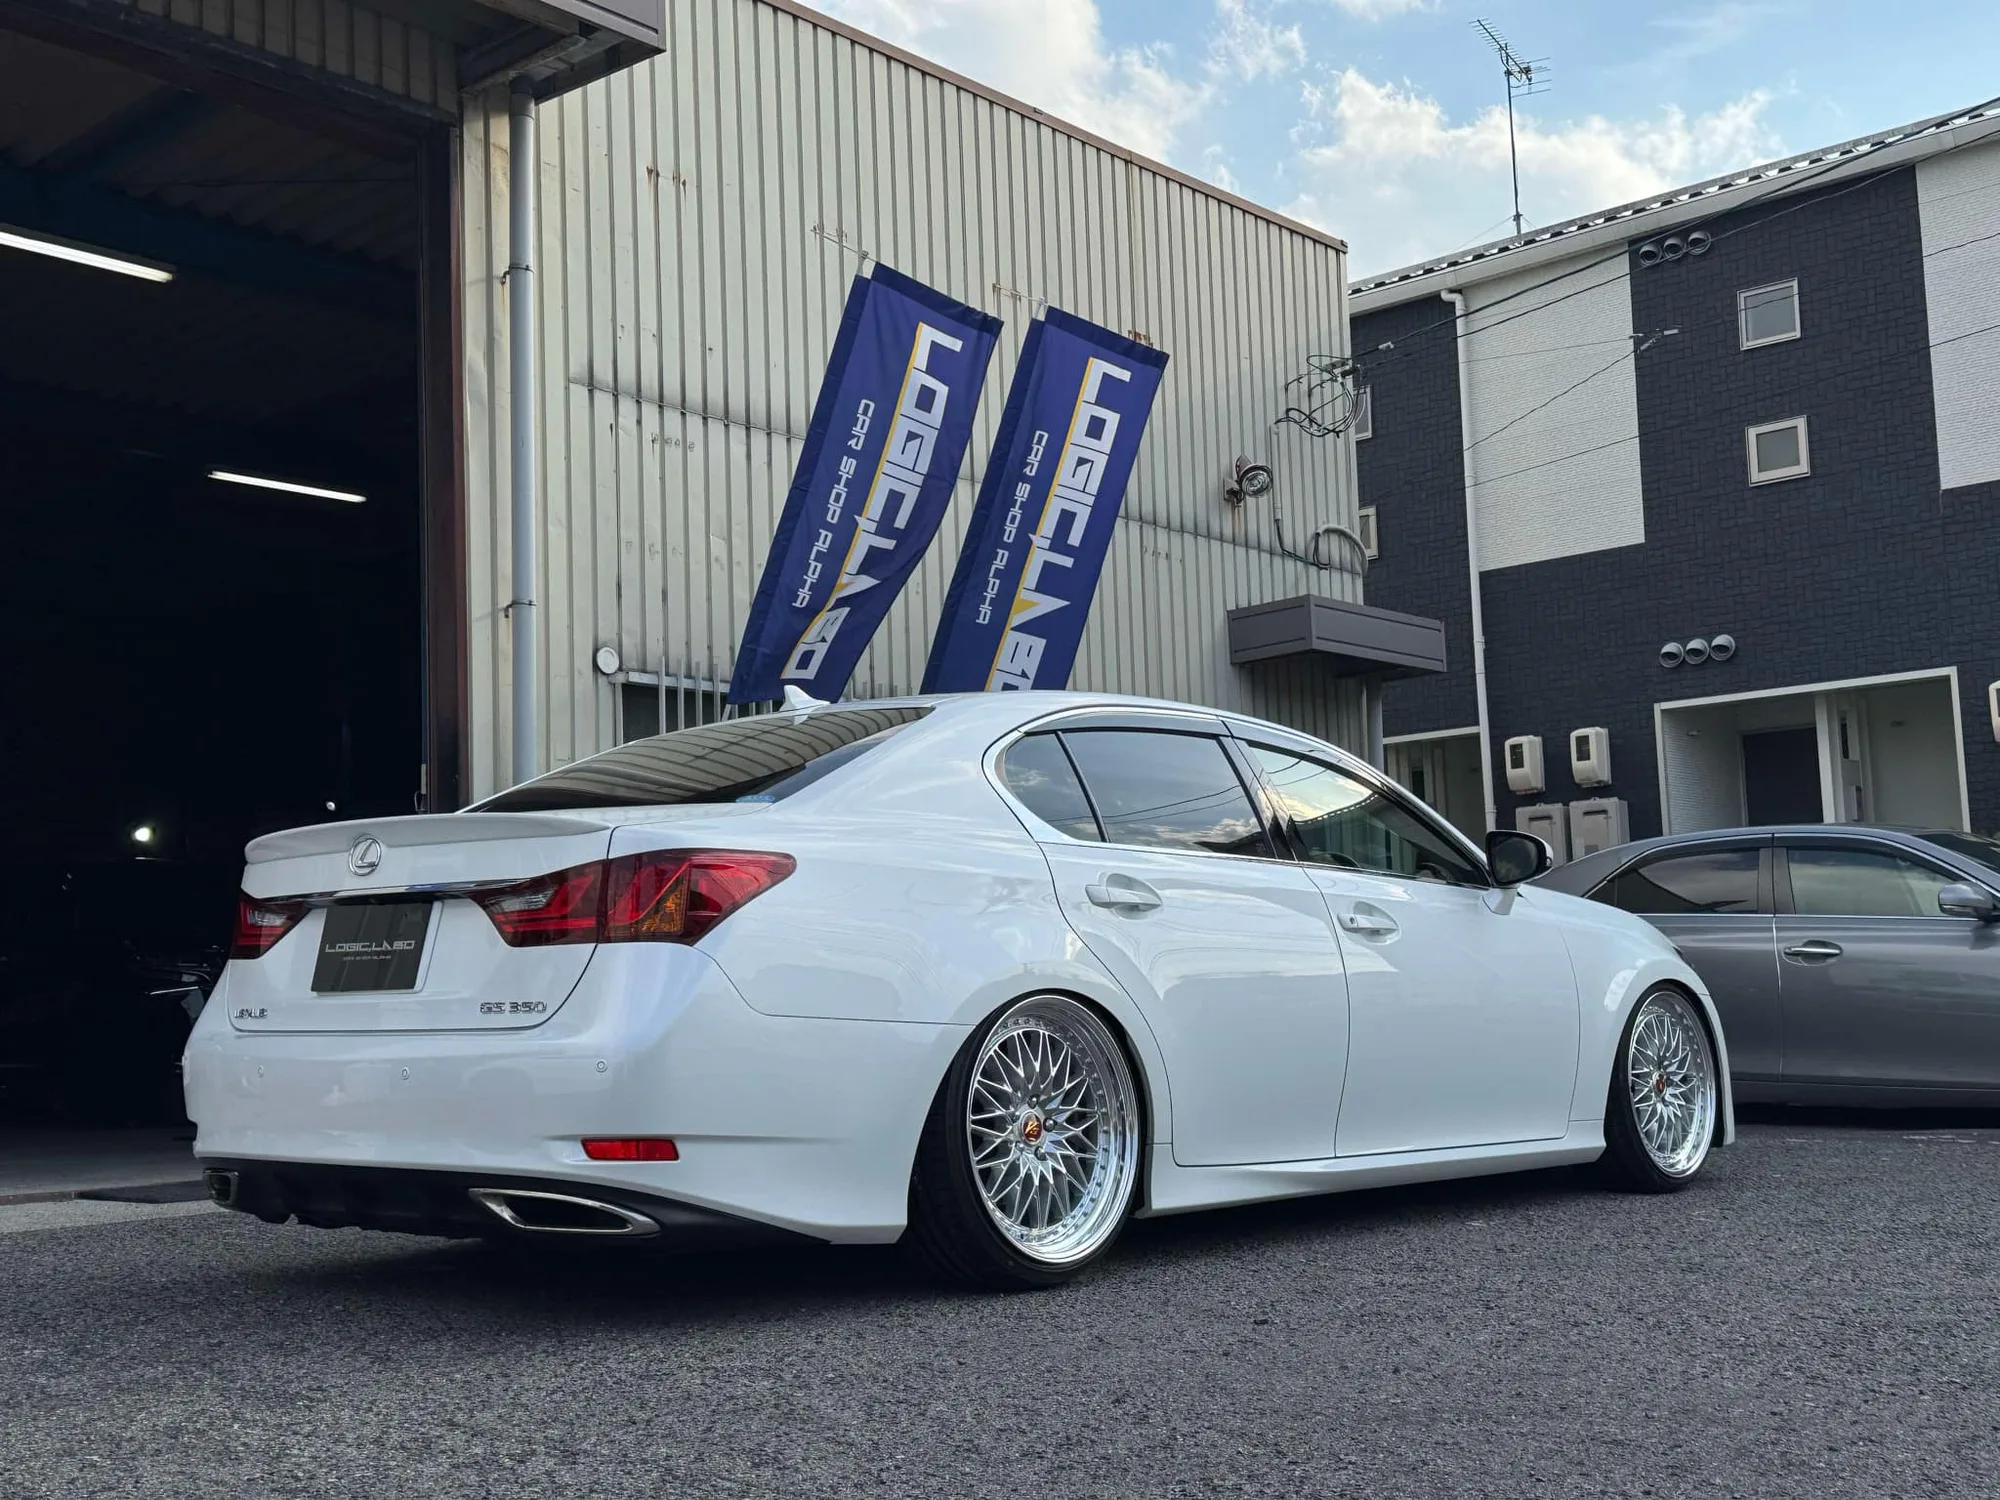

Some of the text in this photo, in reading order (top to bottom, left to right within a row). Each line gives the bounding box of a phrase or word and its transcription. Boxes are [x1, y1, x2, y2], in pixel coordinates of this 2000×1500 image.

[792, 399, 875, 608] CAR SHOP ALPHA
[976, 430, 1048, 624] CAR SHOP ALPHA
[480, 1001, 548, 1014] GS 350
